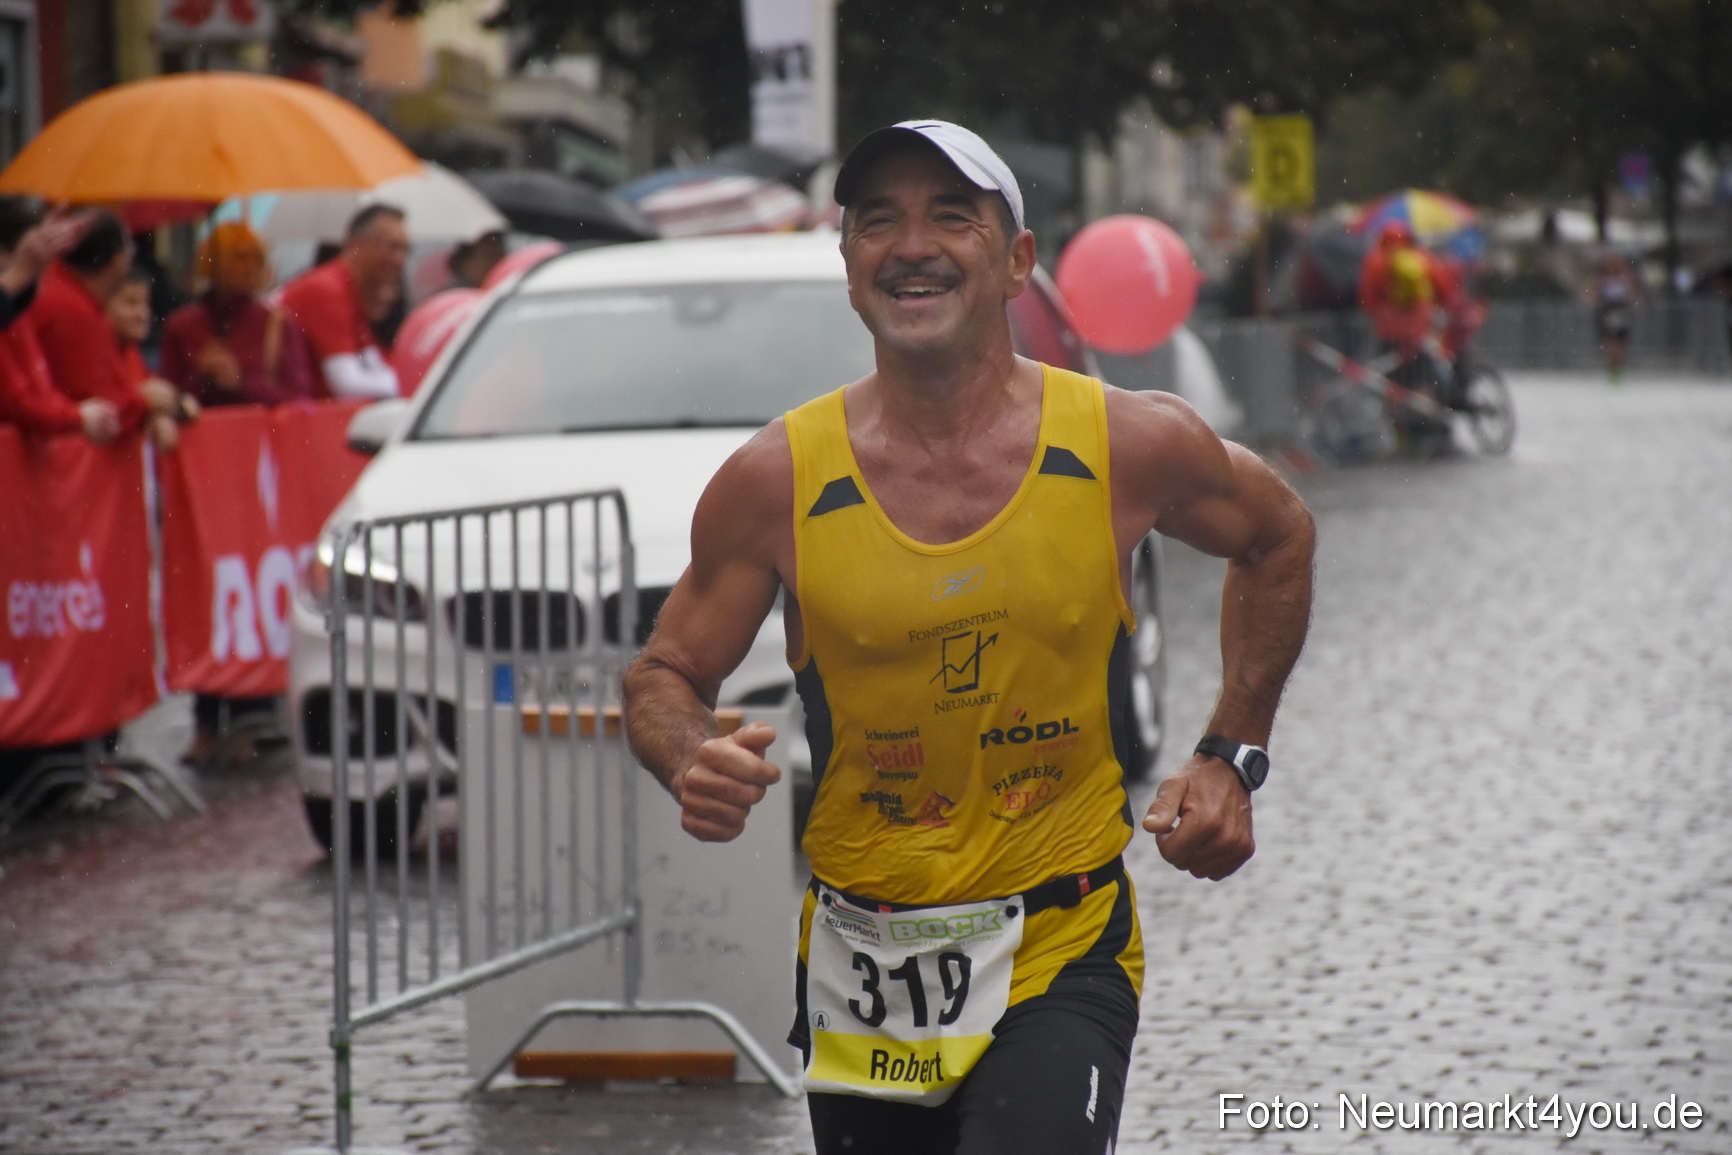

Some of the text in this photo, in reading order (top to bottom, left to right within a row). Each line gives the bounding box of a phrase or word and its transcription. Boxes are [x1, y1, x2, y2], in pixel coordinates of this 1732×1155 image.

[934, 692, 1000, 714] NEUMARKT
[865, 726, 920, 740] Schreinerei
[866, 743, 925, 769] Seidl
[889, 908, 1003, 941] BOCK
[848, 952, 972, 1028] 319
[816, 1014, 825, 1027] A
[870, 1049, 944, 1083] Robert
